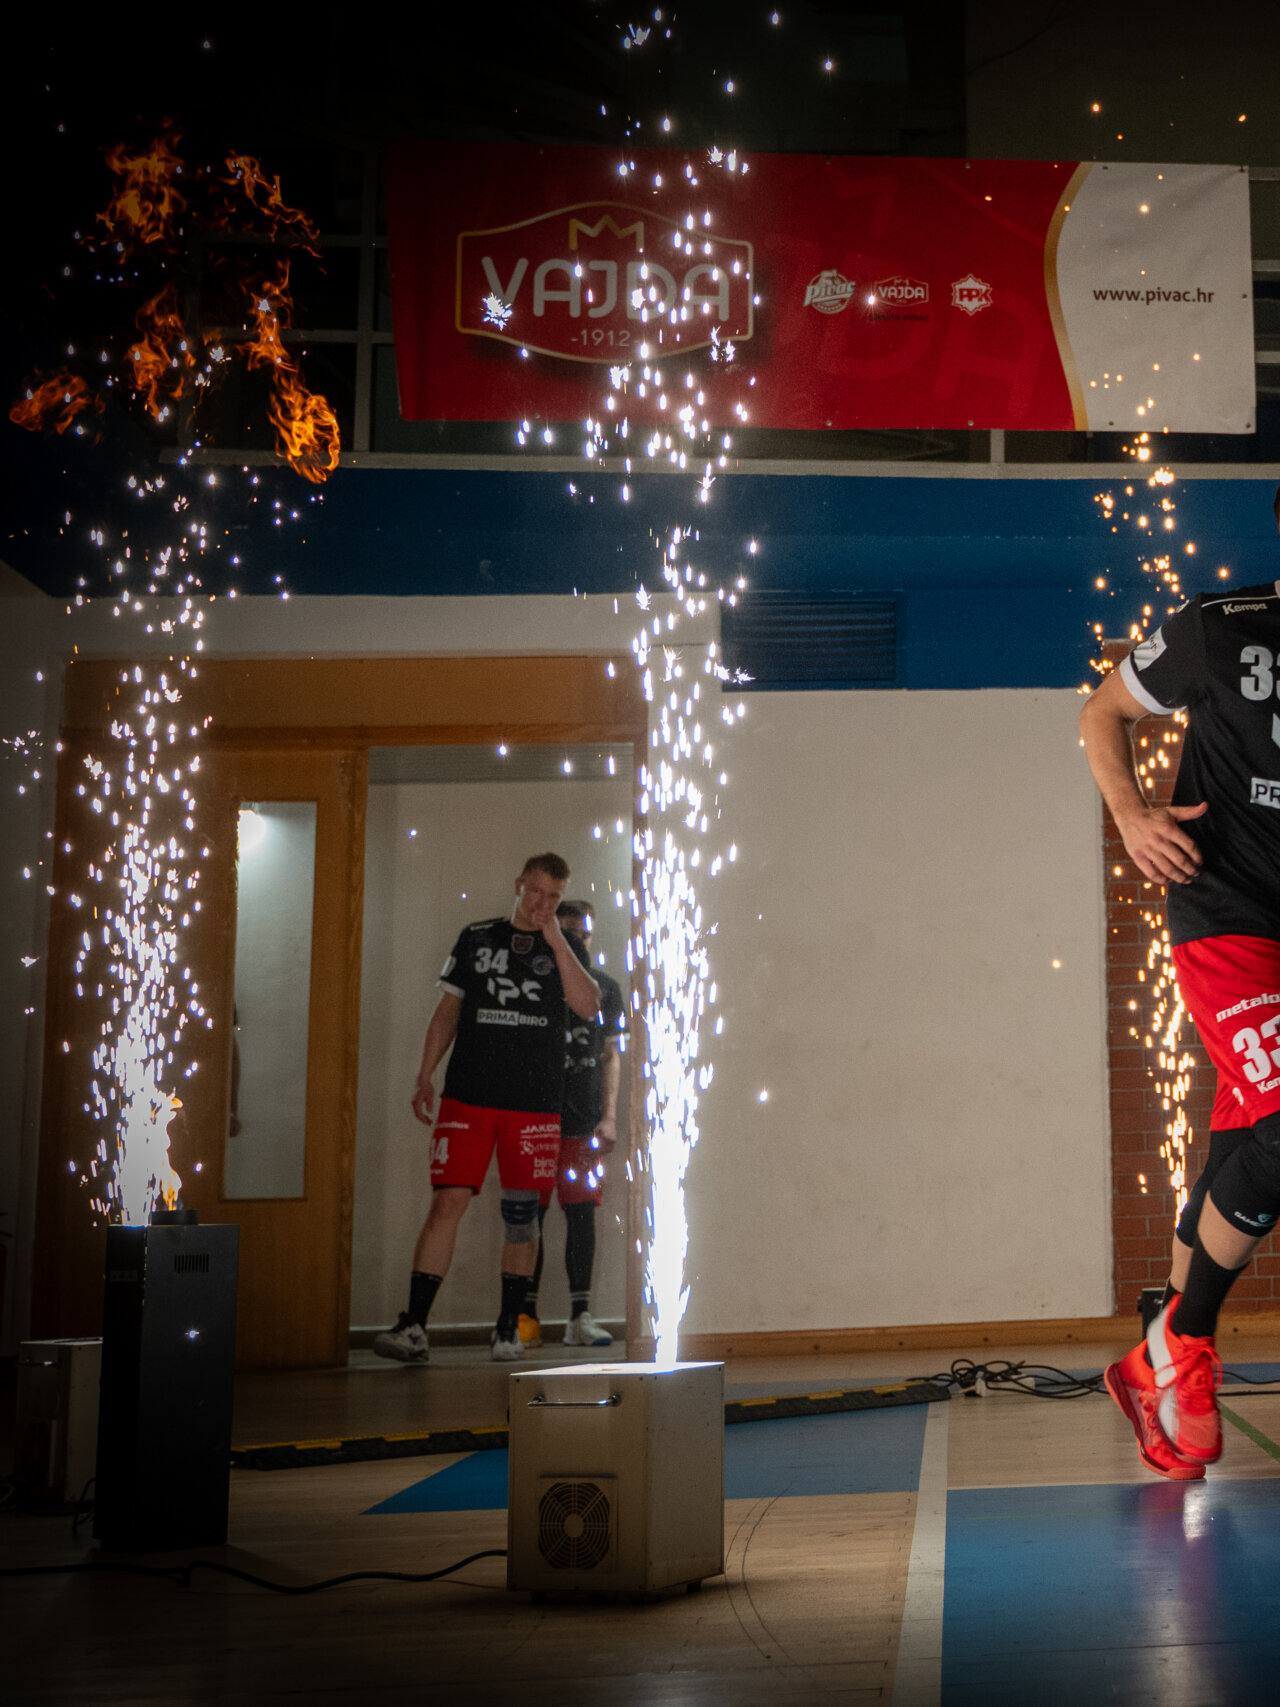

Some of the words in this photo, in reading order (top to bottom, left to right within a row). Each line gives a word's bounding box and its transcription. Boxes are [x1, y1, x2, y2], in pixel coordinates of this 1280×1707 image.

[482, 256, 730, 322] VAJDA
[878, 286, 925, 299] VAJDA
[959, 288, 990, 302] PPK
[1093, 287, 1215, 305] www.pivac.hr
[1222, 602, 1268, 616] Kempa
[475, 947, 509, 975] 34
